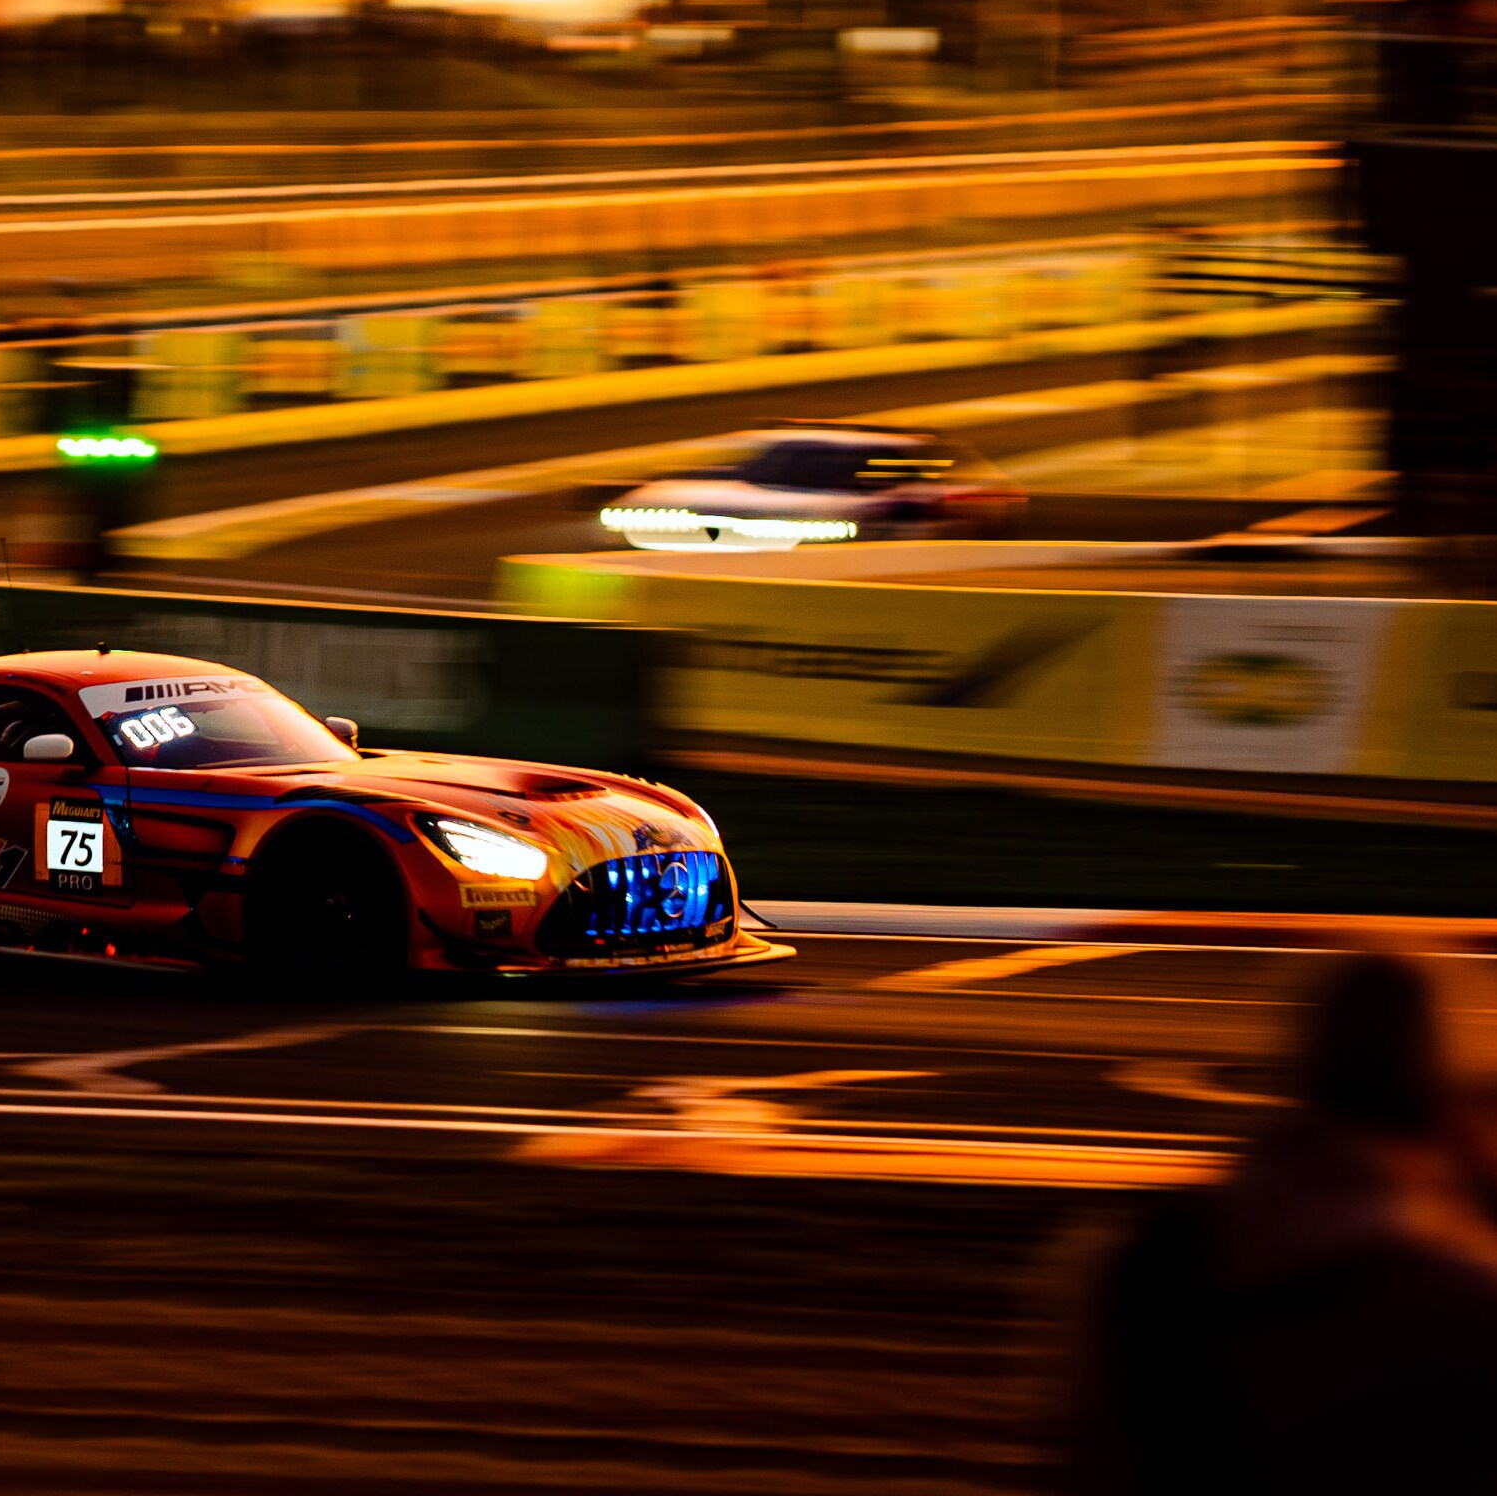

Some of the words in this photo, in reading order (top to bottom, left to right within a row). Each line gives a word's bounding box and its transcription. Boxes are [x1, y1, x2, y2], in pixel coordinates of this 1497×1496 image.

[120, 707, 195, 749] 006
[60, 830, 96, 867] 75
[58, 873, 93, 891] PRO
